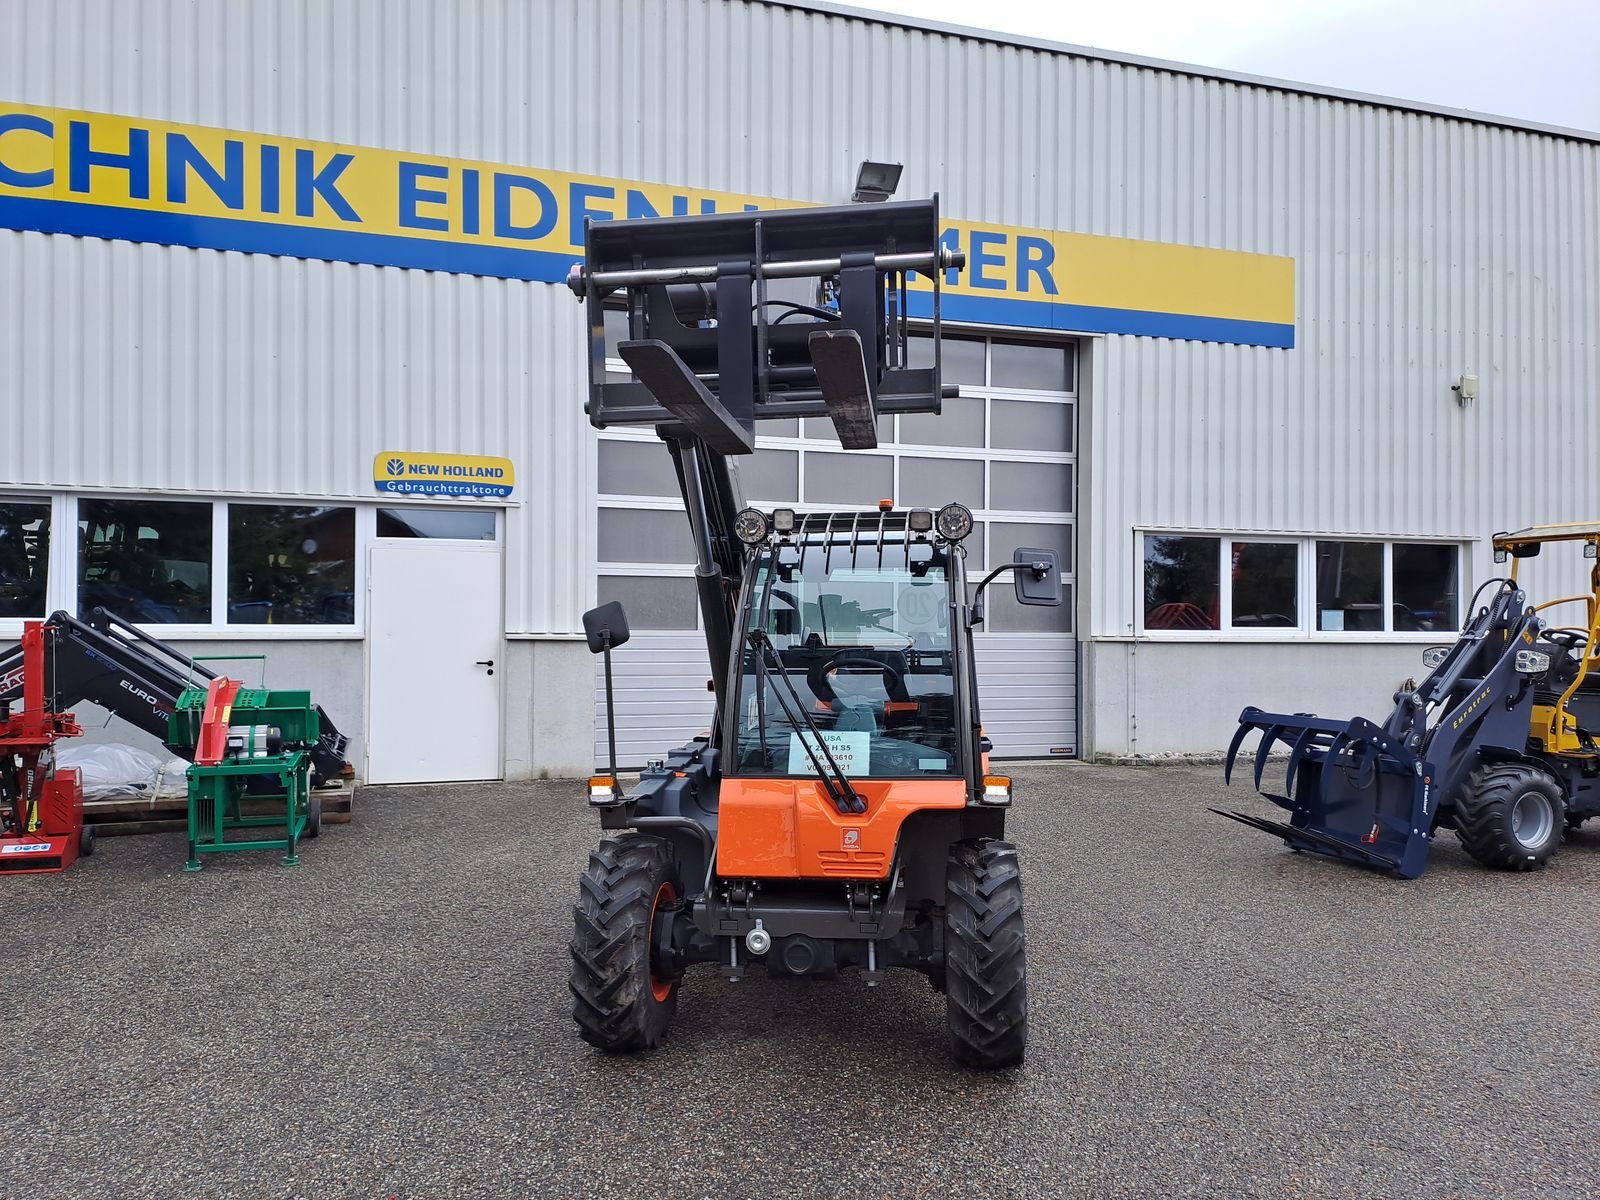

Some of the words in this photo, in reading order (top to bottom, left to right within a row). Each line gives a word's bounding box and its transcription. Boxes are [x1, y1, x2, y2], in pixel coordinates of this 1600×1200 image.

[408, 463, 440, 475] NEW
[443, 465, 504, 478] HOLLAND
[386, 480, 505, 496] Gebrauchttraktore
[1453, 686, 1491, 729] Eurotrac
